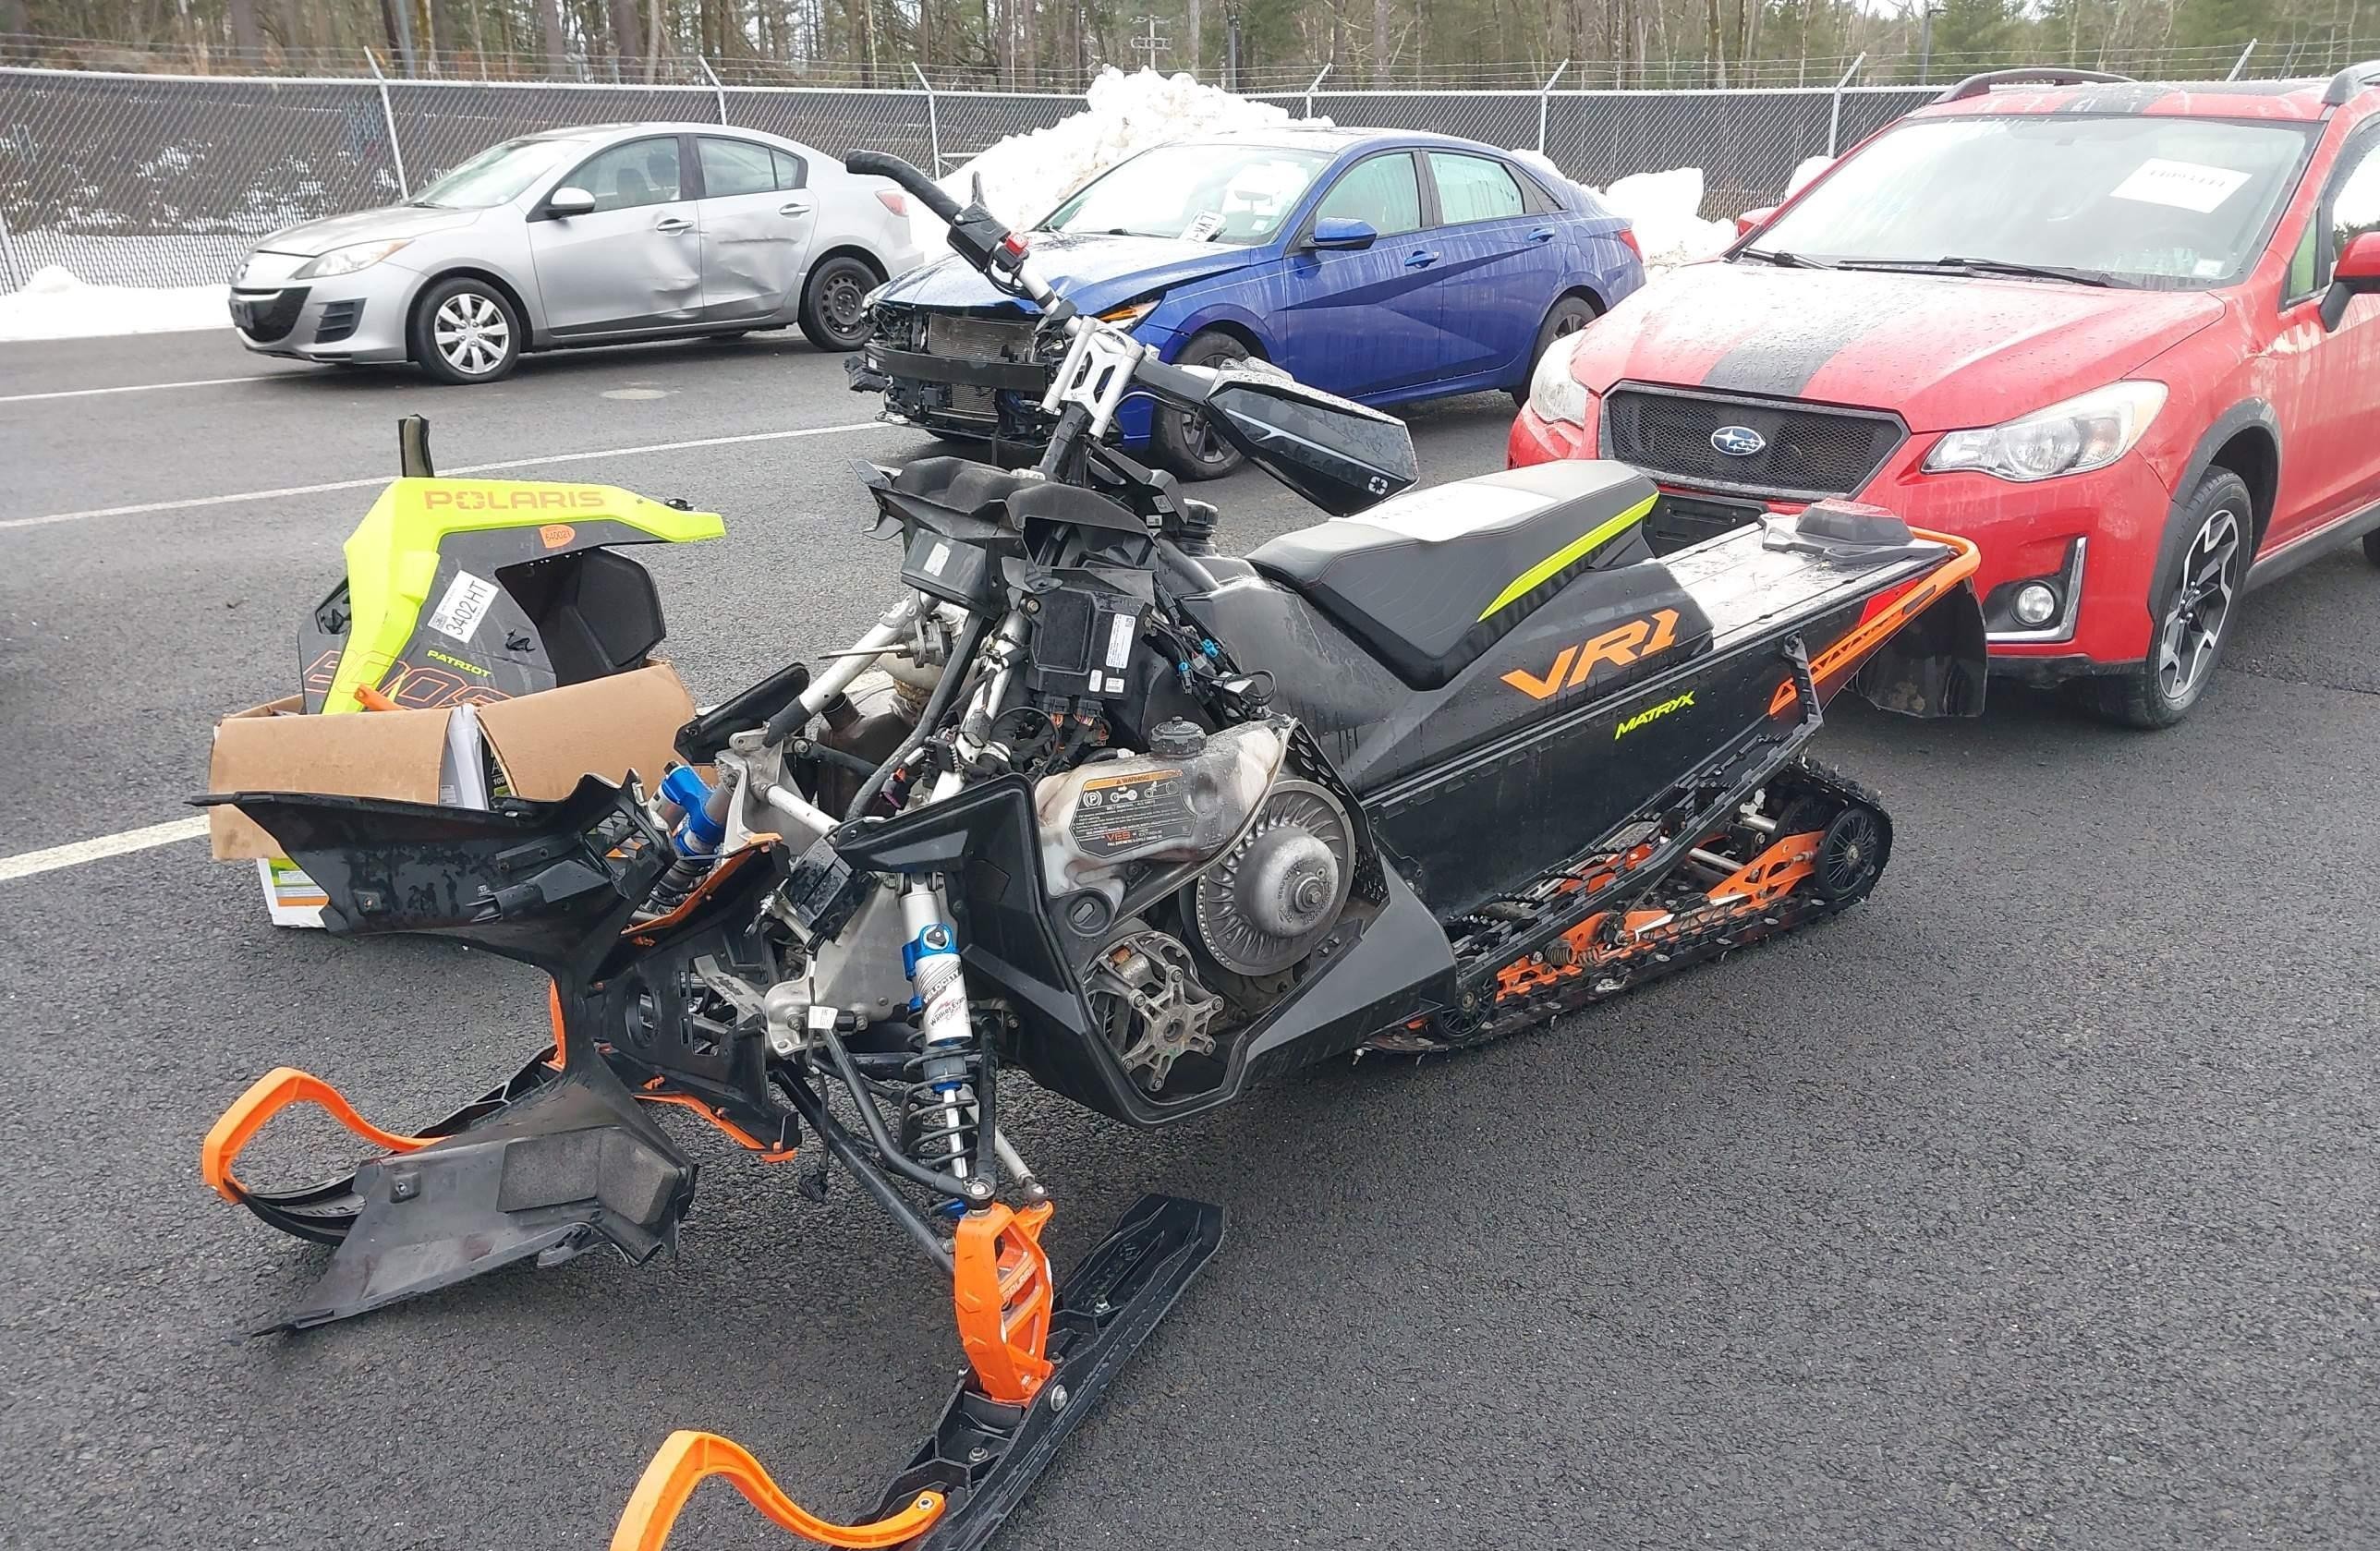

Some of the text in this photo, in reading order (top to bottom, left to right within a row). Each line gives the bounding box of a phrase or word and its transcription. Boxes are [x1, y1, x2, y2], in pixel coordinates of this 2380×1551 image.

[423, 490, 606, 511] POLARIS
[427, 649, 492, 678] PATRIOT
[1499, 608, 1681, 700] VR1
[1614, 690, 1695, 740] MATRYX
[923, 968, 960, 1004] VELOCITY
